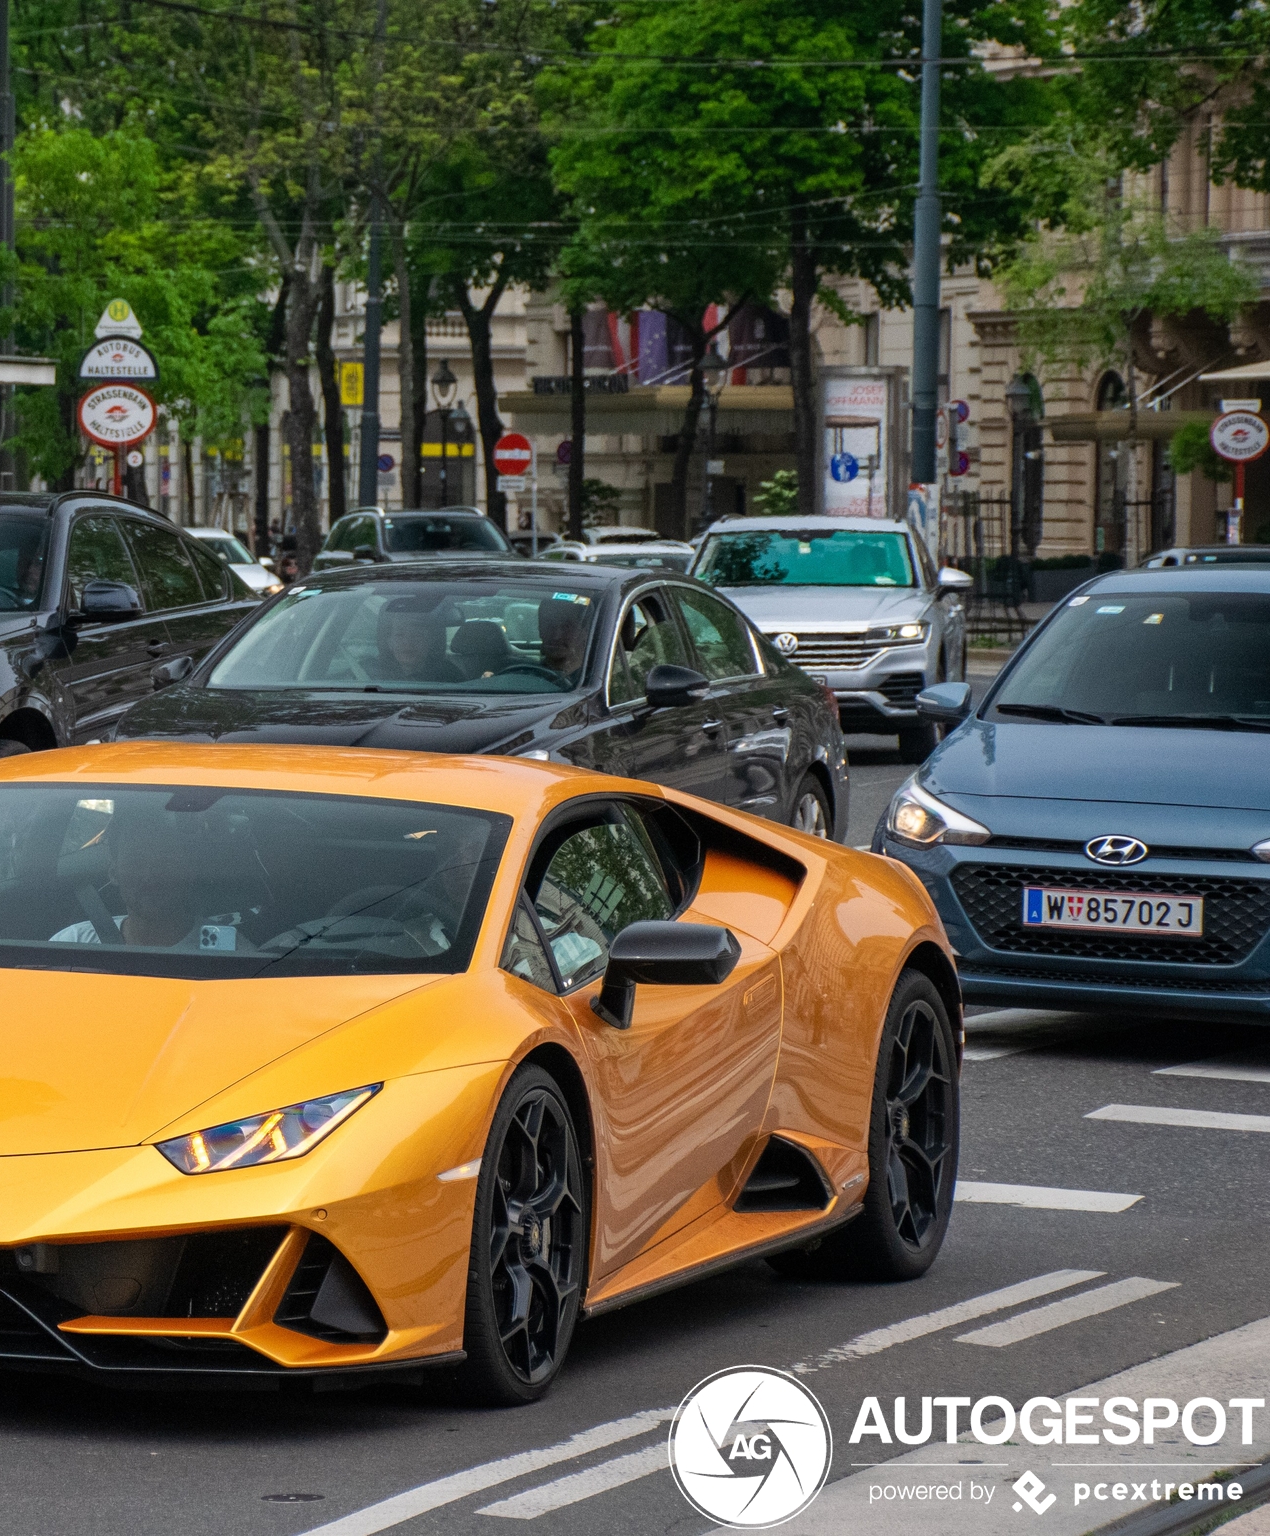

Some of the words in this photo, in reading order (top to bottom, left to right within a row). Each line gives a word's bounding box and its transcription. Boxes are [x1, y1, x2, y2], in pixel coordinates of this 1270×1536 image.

[97, 343, 141, 358] AUTOBUS
[87, 365, 149, 376] HALTESTELLE
[87, 389, 148, 411] STRASSENBAHN
[90, 420, 146, 438] HALTESTELLE
[1046, 895, 1065, 920] W
[1086, 897, 1171, 927] 85702
[1177, 902, 1193, 928] J
